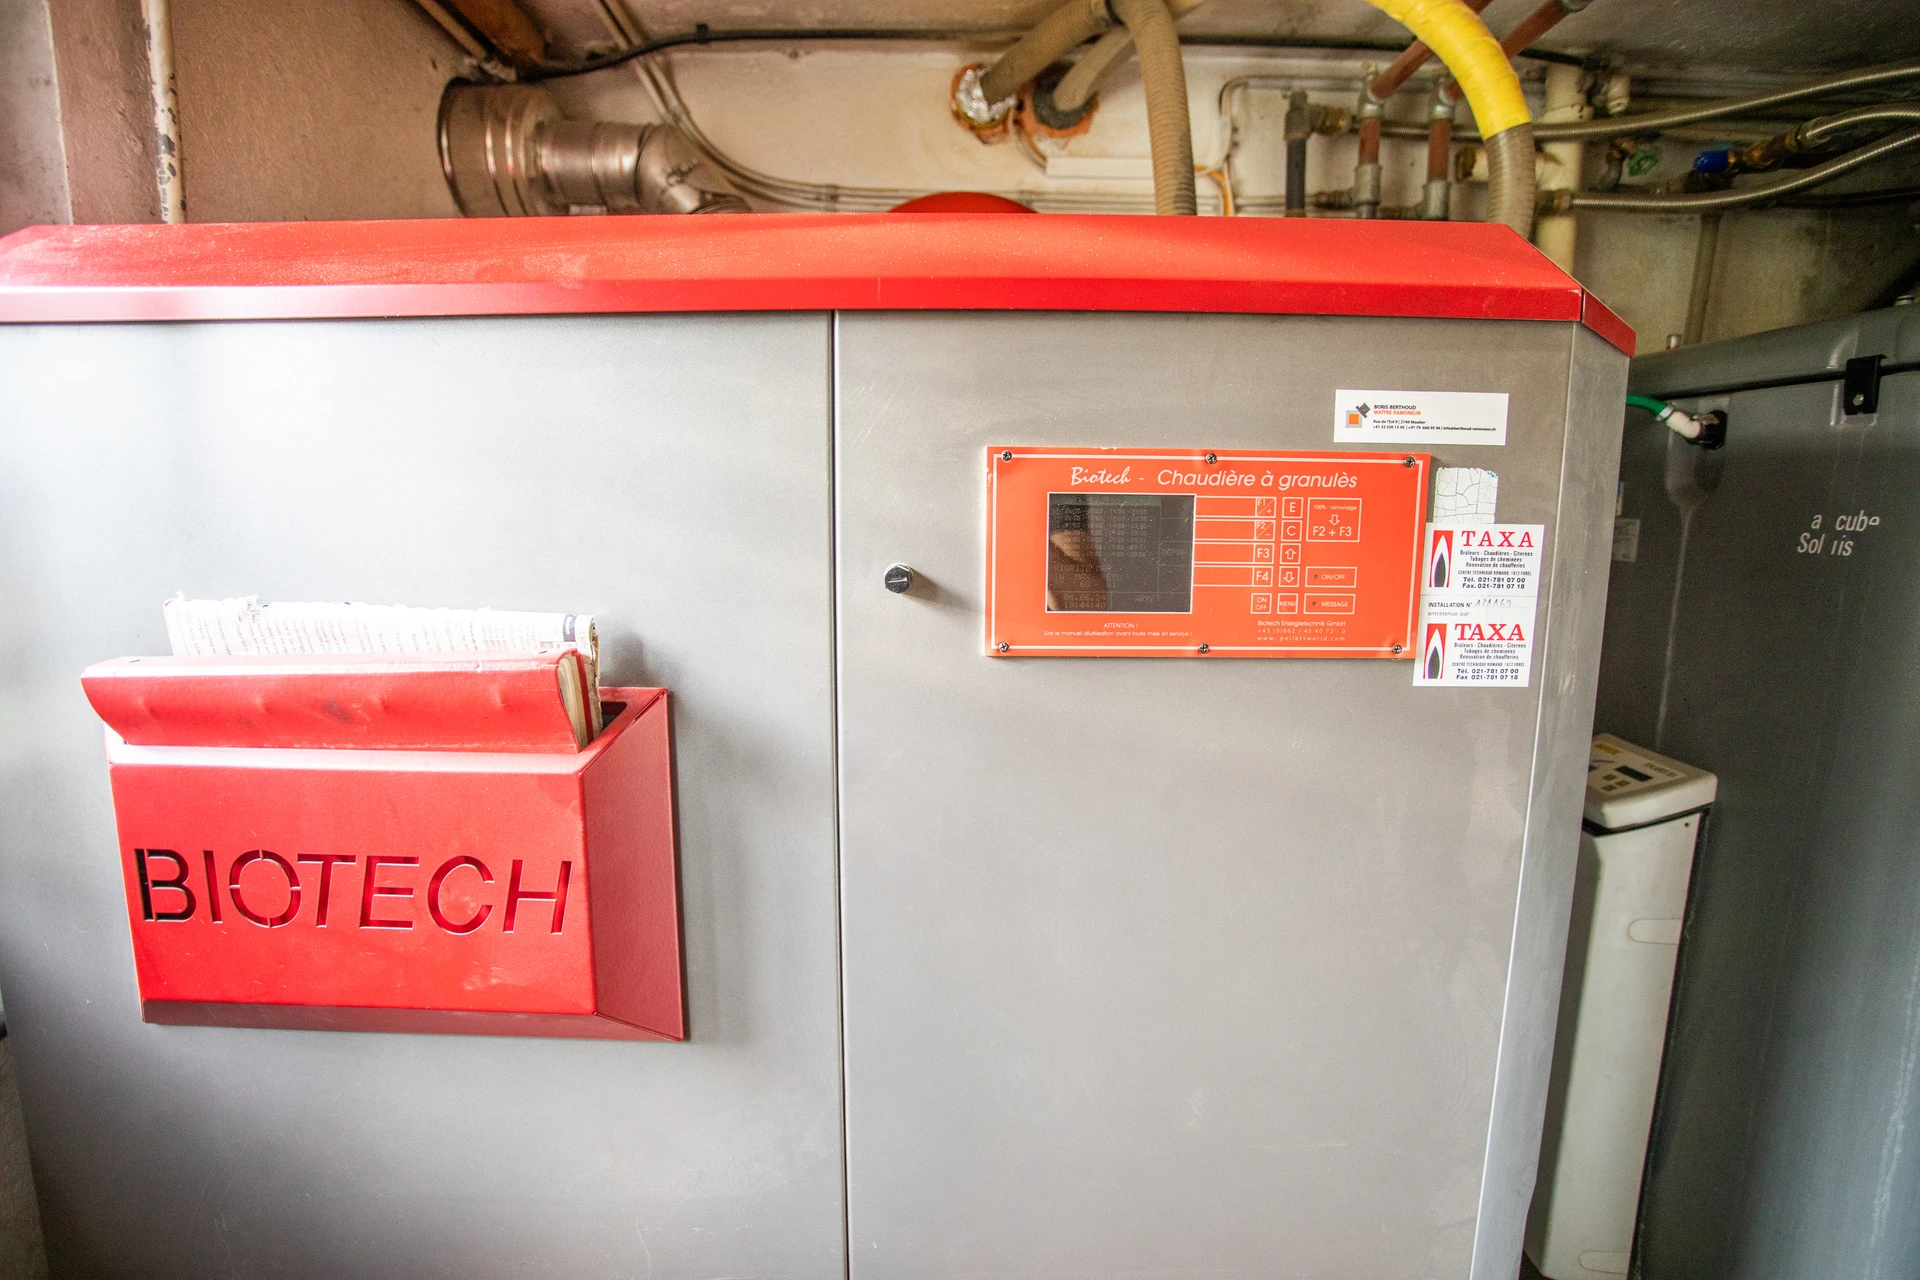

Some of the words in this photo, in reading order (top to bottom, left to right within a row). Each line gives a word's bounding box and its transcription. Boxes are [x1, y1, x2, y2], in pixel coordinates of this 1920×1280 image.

[1070, 466, 1131, 486] Biotech
[1157, 469, 1256, 486] Chaudière
[1261, 470, 1273, 487] à
[1278, 472, 1357, 491] granulès
[1289, 502, 1296, 512] E
[1811, 514, 1823, 529] a
[1286, 525, 1296, 536] C
[1313, 526, 1325, 536] F2
[1340, 526, 1352, 537] F3
[1461, 531, 1534, 548] TAXA
[1257, 548, 1270, 558] F3
[1256, 571, 1269, 581] F4
[1454, 623, 1525, 641] TAXA
[134, 849, 572, 935] BIOTECH
